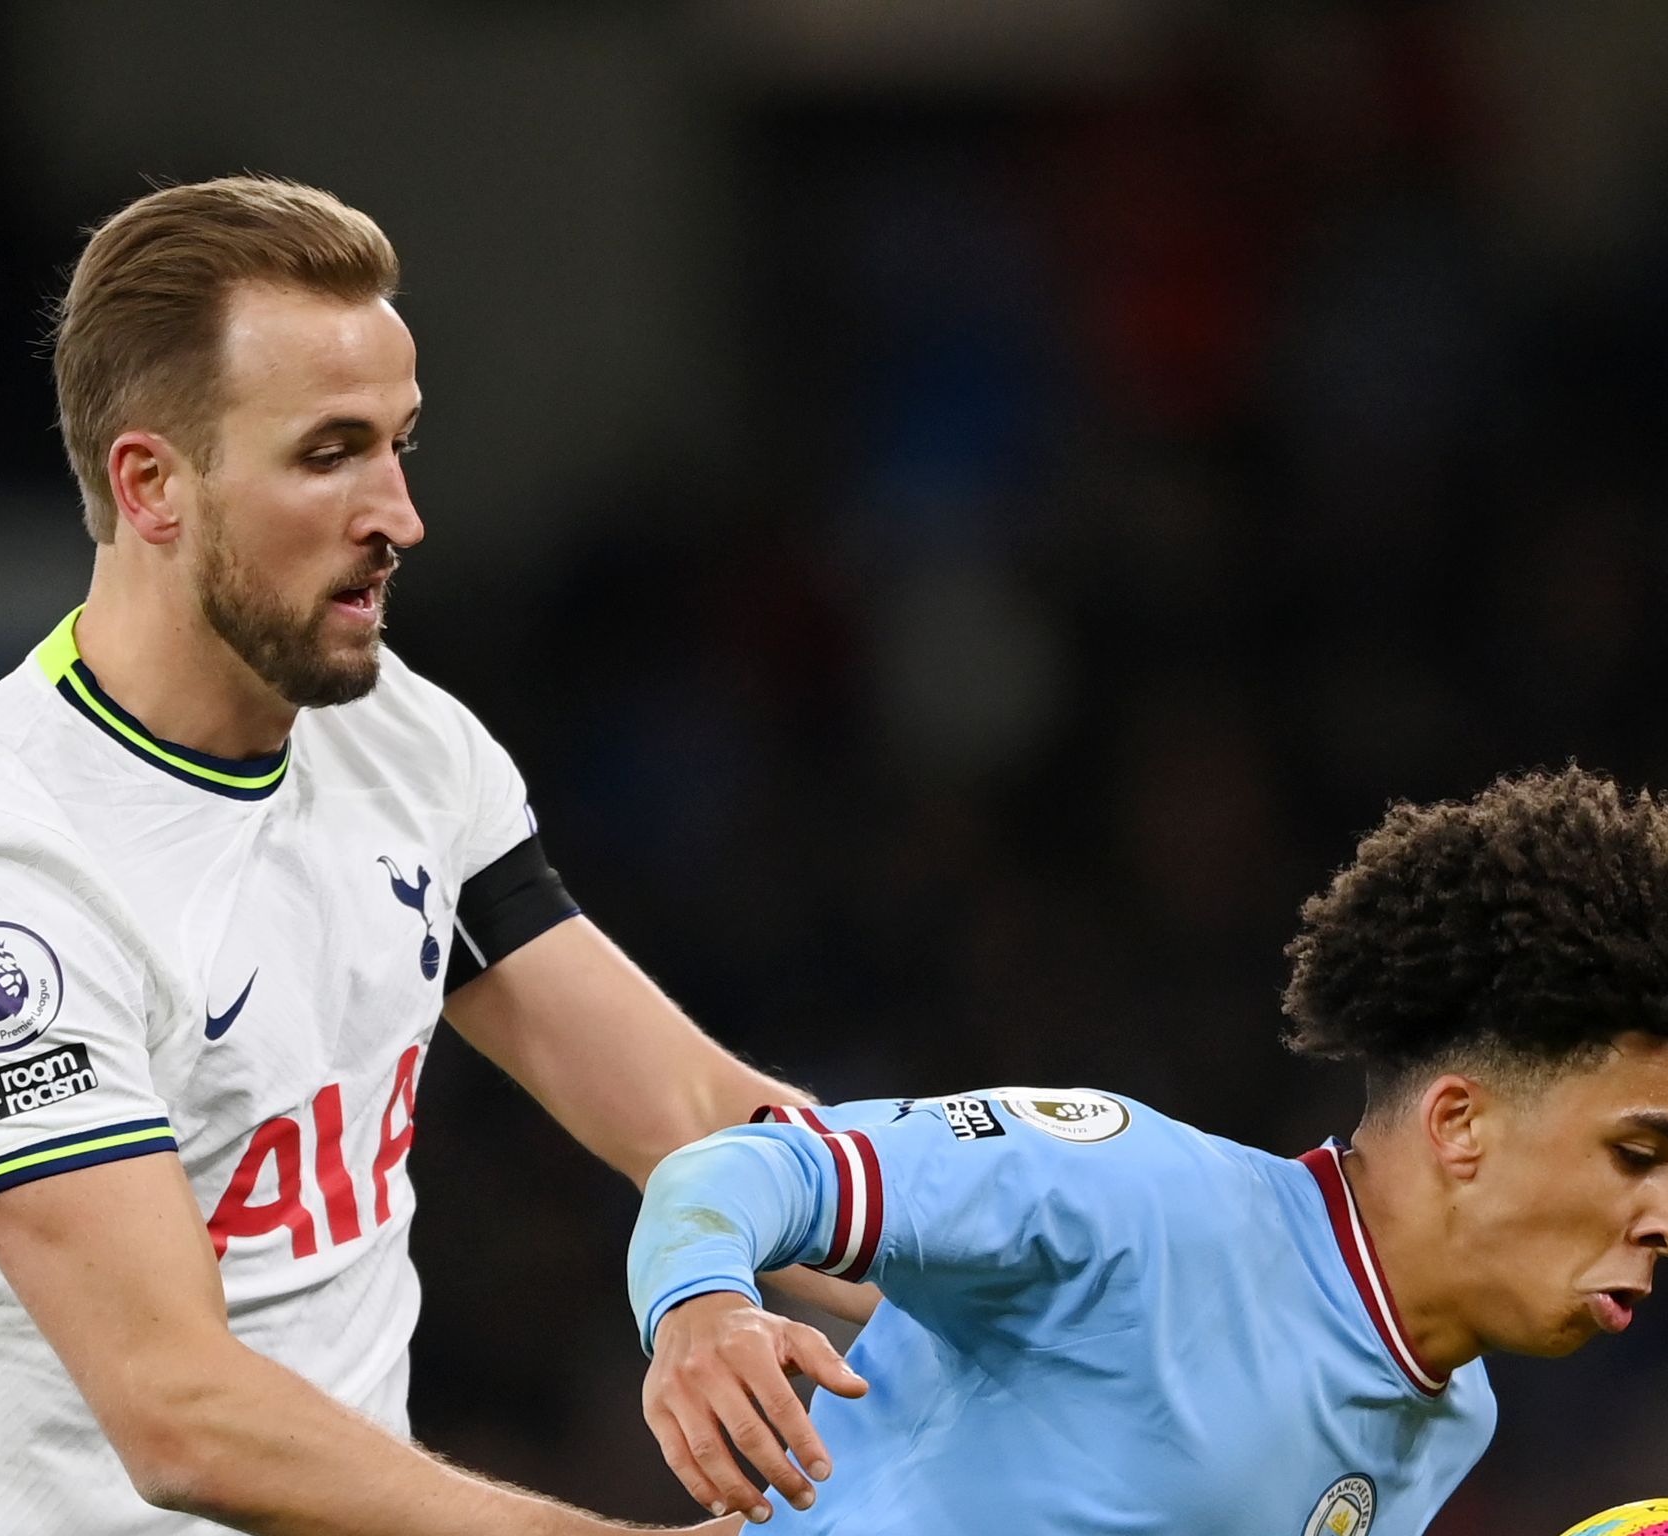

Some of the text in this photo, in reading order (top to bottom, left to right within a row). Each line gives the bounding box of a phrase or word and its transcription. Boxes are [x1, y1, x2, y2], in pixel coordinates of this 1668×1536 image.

[0, 978, 51, 1040] Premier League
[1, 1050, 78, 1090] room
[5, 1068, 97, 1114] racism
[1327, 1481, 1371, 1529] MANCHESTER
